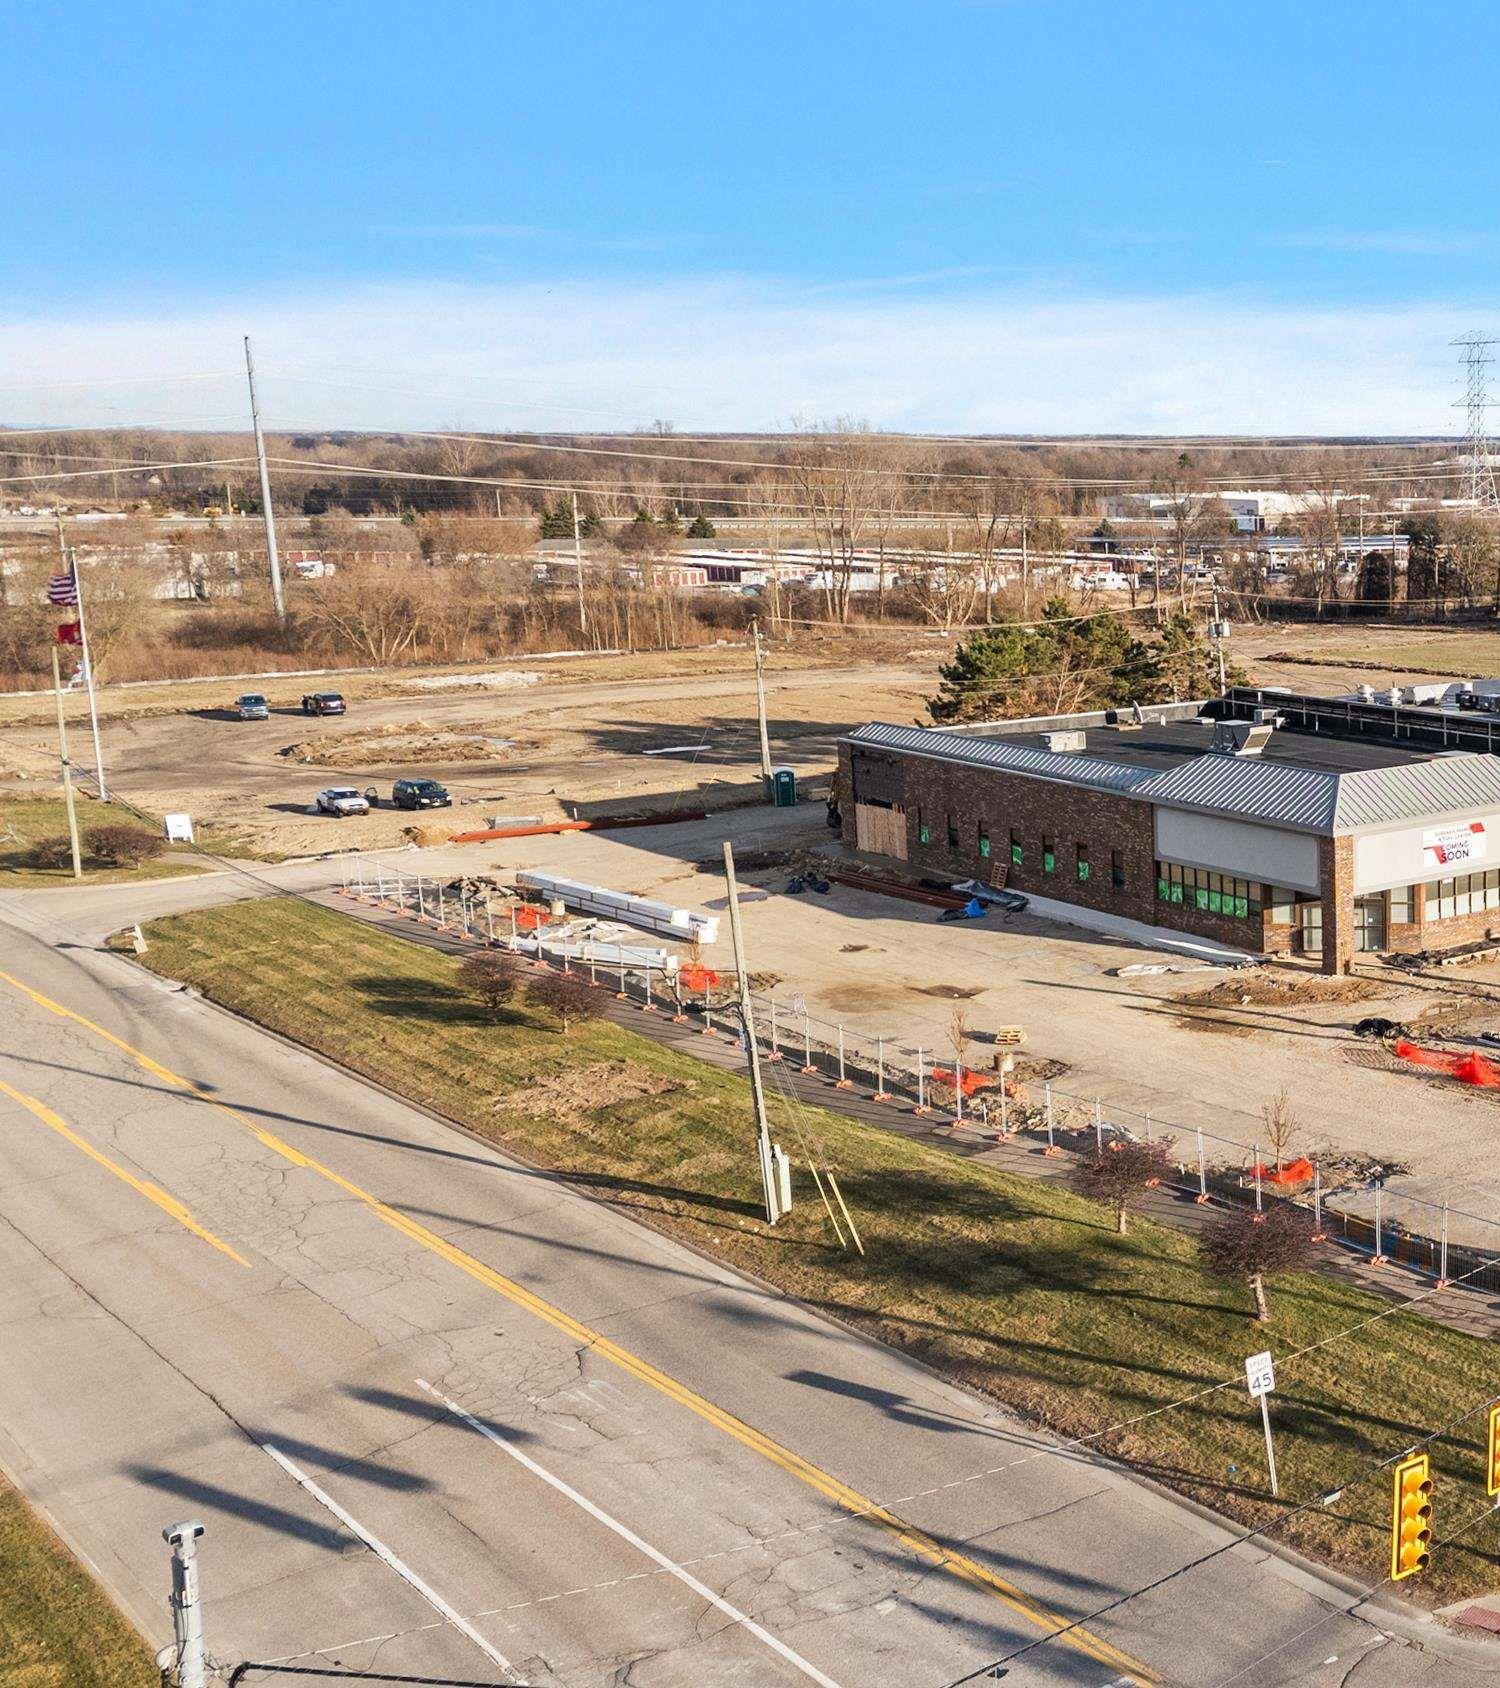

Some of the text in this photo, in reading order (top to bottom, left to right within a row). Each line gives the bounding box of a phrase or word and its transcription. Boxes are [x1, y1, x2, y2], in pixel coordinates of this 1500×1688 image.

[1440, 840, 1470, 852] COMING
[1440, 849, 1470, 863] SOON
[1252, 1372, 1272, 1390] 45
